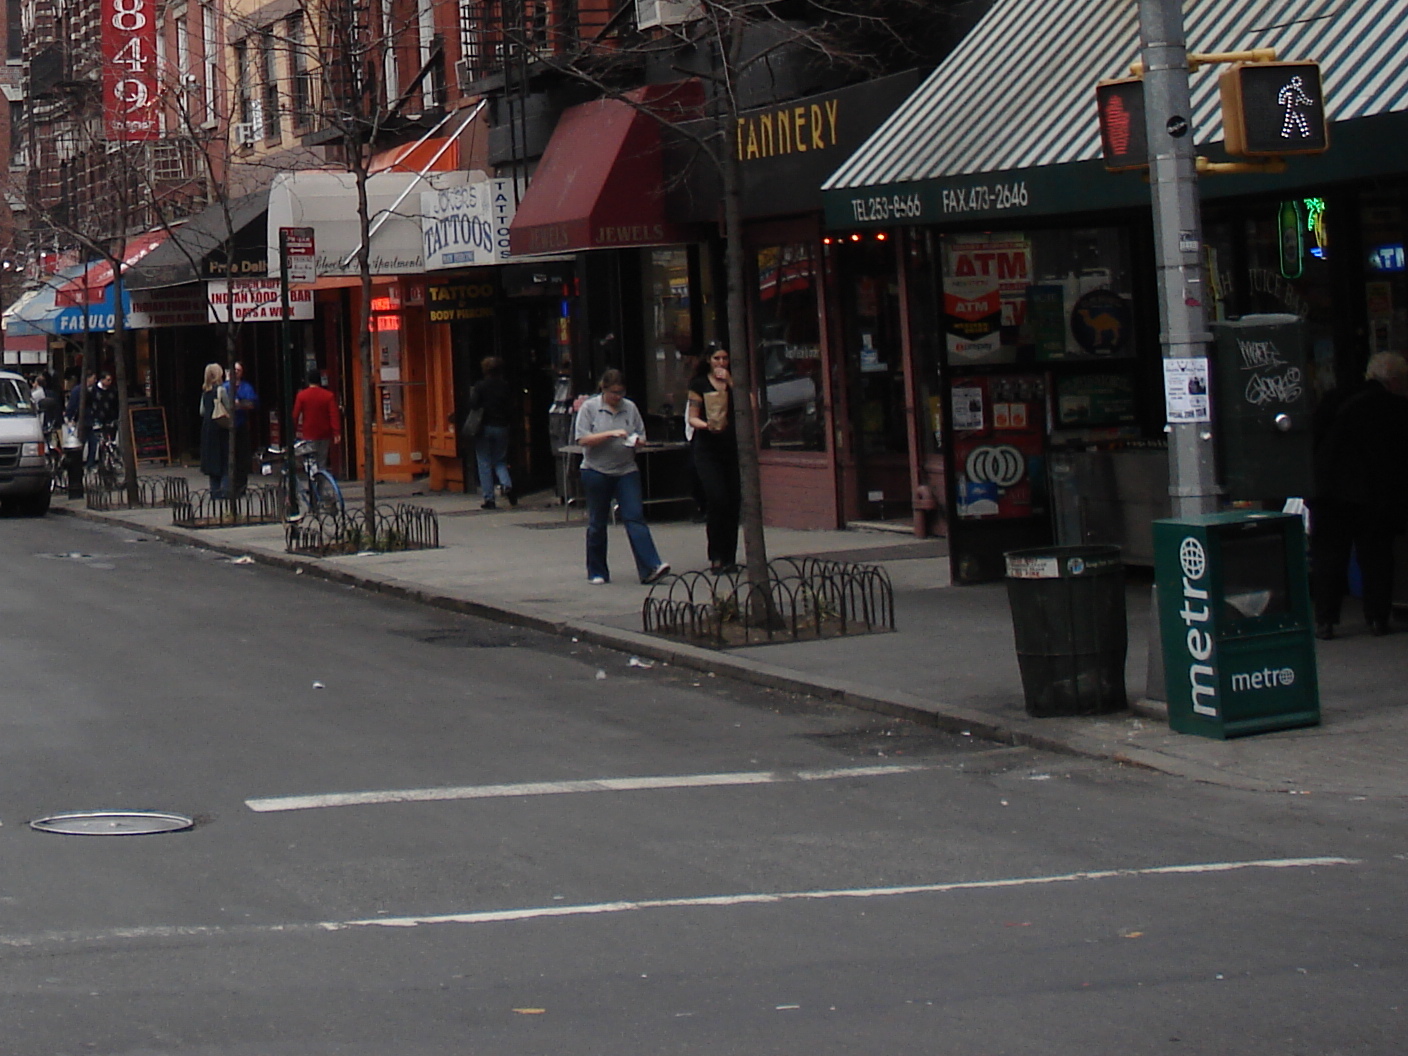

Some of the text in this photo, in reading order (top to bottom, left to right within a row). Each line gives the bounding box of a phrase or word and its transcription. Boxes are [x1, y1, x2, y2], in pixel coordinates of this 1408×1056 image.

[737, 99, 838, 161] TANNERY
[942, 181, 1028, 213] FAX.473-2646
[495, 182, 511, 259] TATTOOS
[425, 214, 493, 260] TATTOOS
[596, 224, 664, 243] JEWELS
[955, 252, 1027, 279] ATM
[212, 293, 247, 304] INDAN
[291, 290, 311, 302] BAR
[428, 284, 494, 301] TATTOO
[429, 310, 454, 321] BODY
[955, 302, 988, 312] ATM
[60, 313, 132, 331] FABULOS
[1179, 536, 1219, 718] metro
[1232, 667, 1294, 692] metro
